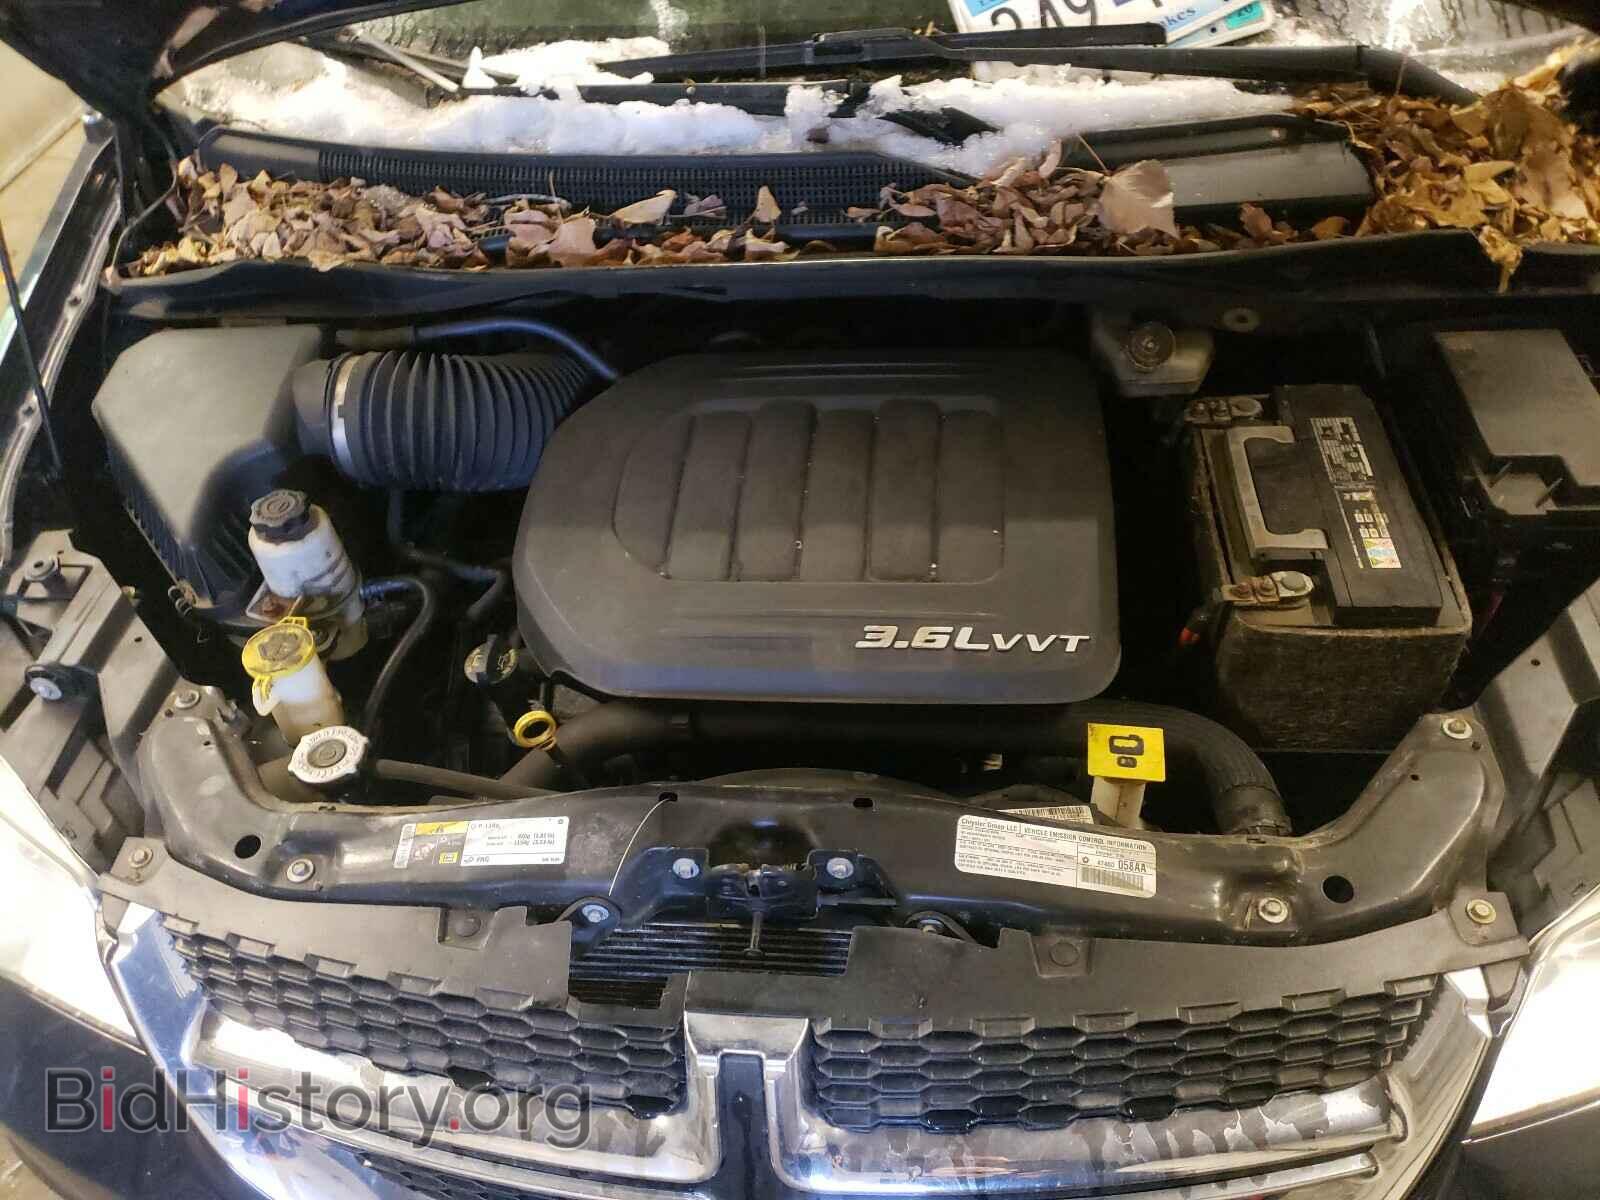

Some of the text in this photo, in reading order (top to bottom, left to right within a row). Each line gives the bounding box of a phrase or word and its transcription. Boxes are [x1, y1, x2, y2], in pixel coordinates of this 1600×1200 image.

[855, 625, 1090, 652] 3.6L VVT
[961, 818, 986, 828] Chrysler
[1024, 826, 1048, 836] VEHICLE
[1049, 830, 1077, 841] EMISSION
[1078, 835, 1105, 845] CONTROL
[1106, 840, 1147, 851] INFORMATION
[1118, 859, 1147, 873] 058AA
